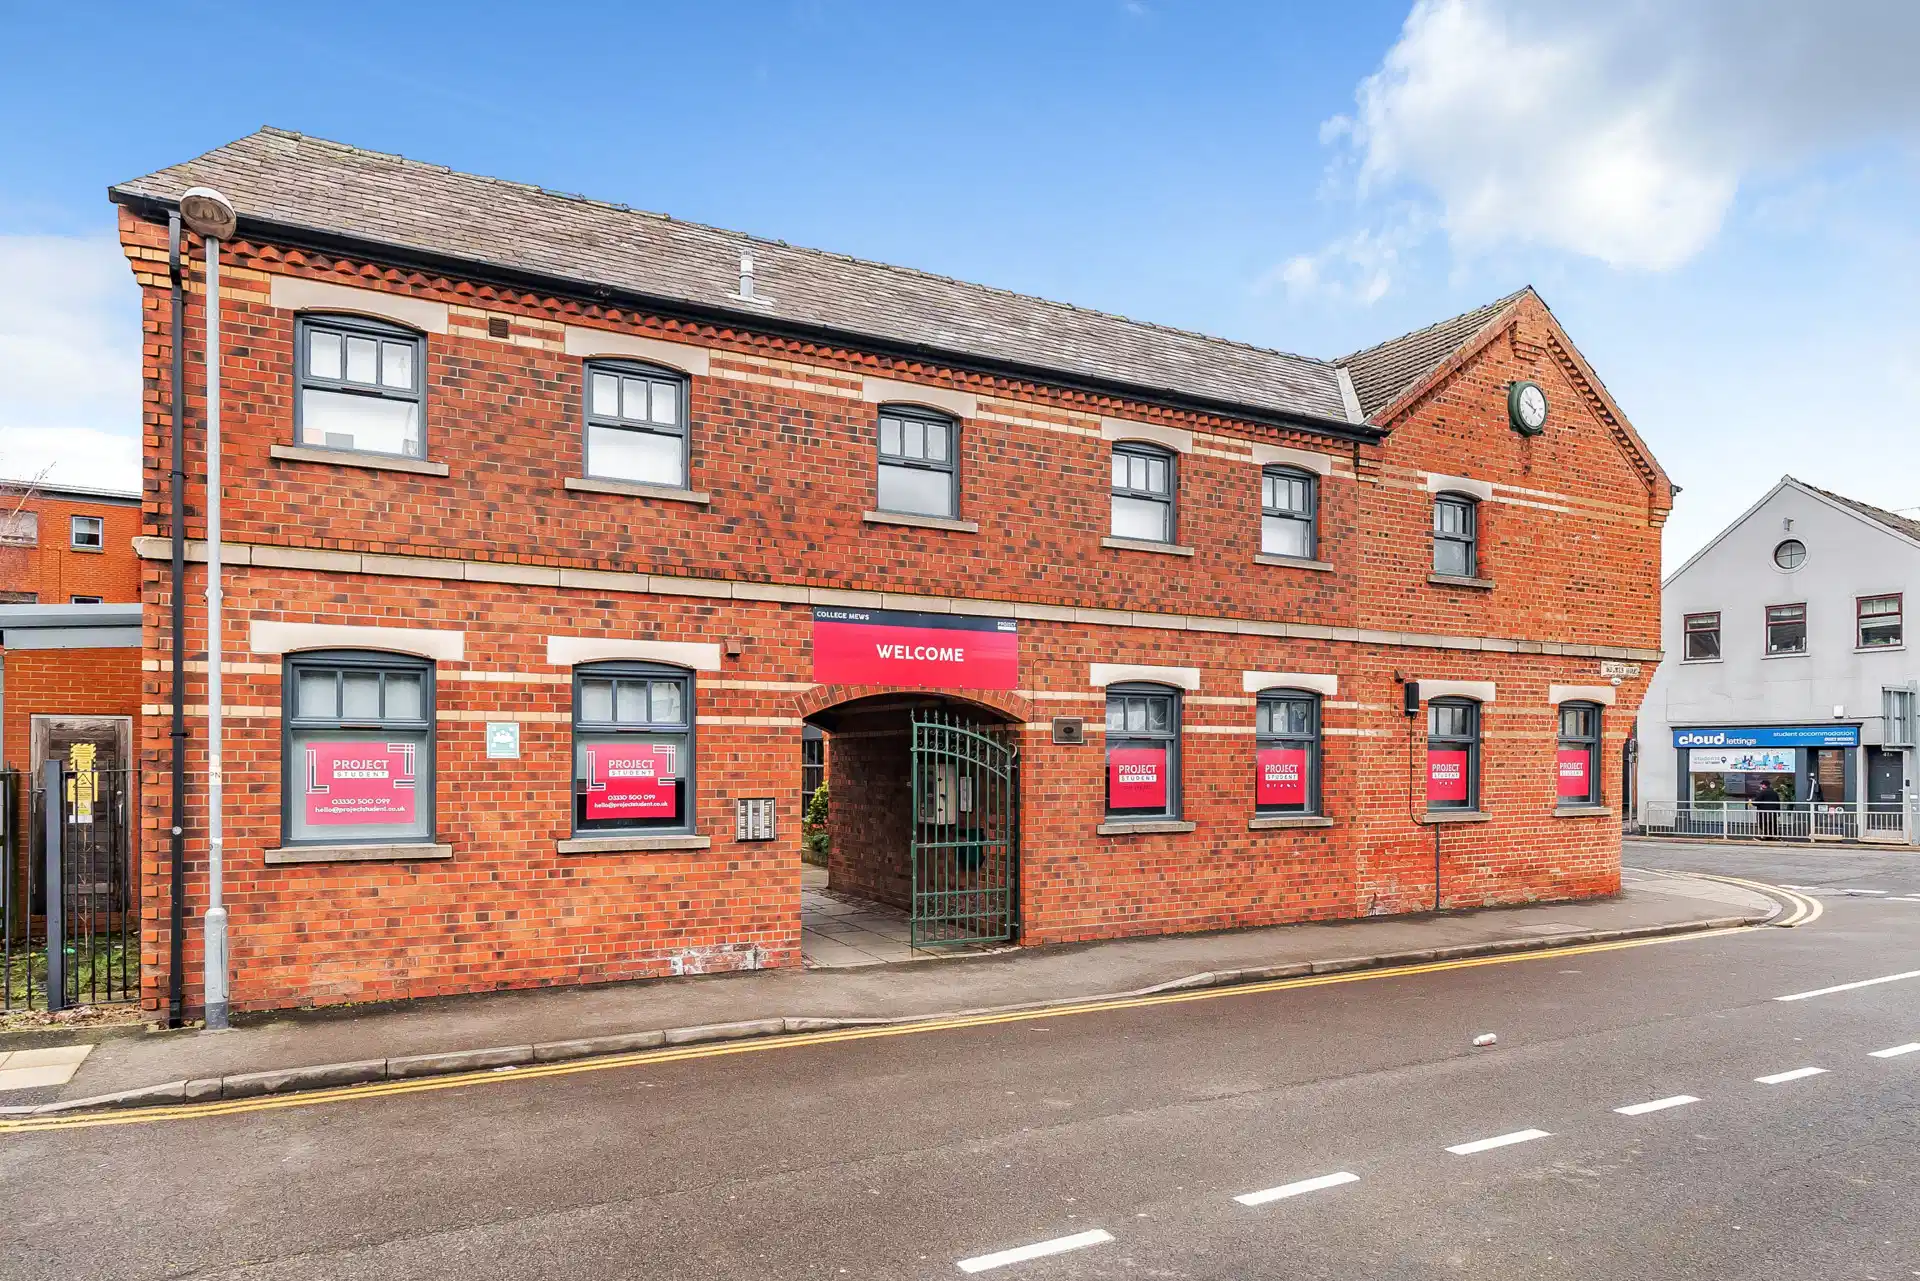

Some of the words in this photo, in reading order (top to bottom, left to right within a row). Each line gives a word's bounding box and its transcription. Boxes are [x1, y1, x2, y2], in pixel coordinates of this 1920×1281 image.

[816, 610, 847, 620] COLLEGE
[848, 613, 870, 621] MEWS
[876, 643, 965, 663] WELCOME
[1678, 733, 1725, 745] cloud
[333, 759, 390, 770] PROJECT
[608, 759, 655, 769] PROJECT
[1118, 764, 1157, 774] PROJECT
[1265, 764, 1299, 773] PROJECT
[1432, 763, 1460, 772] PROJECT
[1560, 762, 1584, 770] PROJECT
[315, 805, 406, 814] hello@projectstudent.co.uk
[594, 801, 668, 809] hello@projectstudent.co.uk
